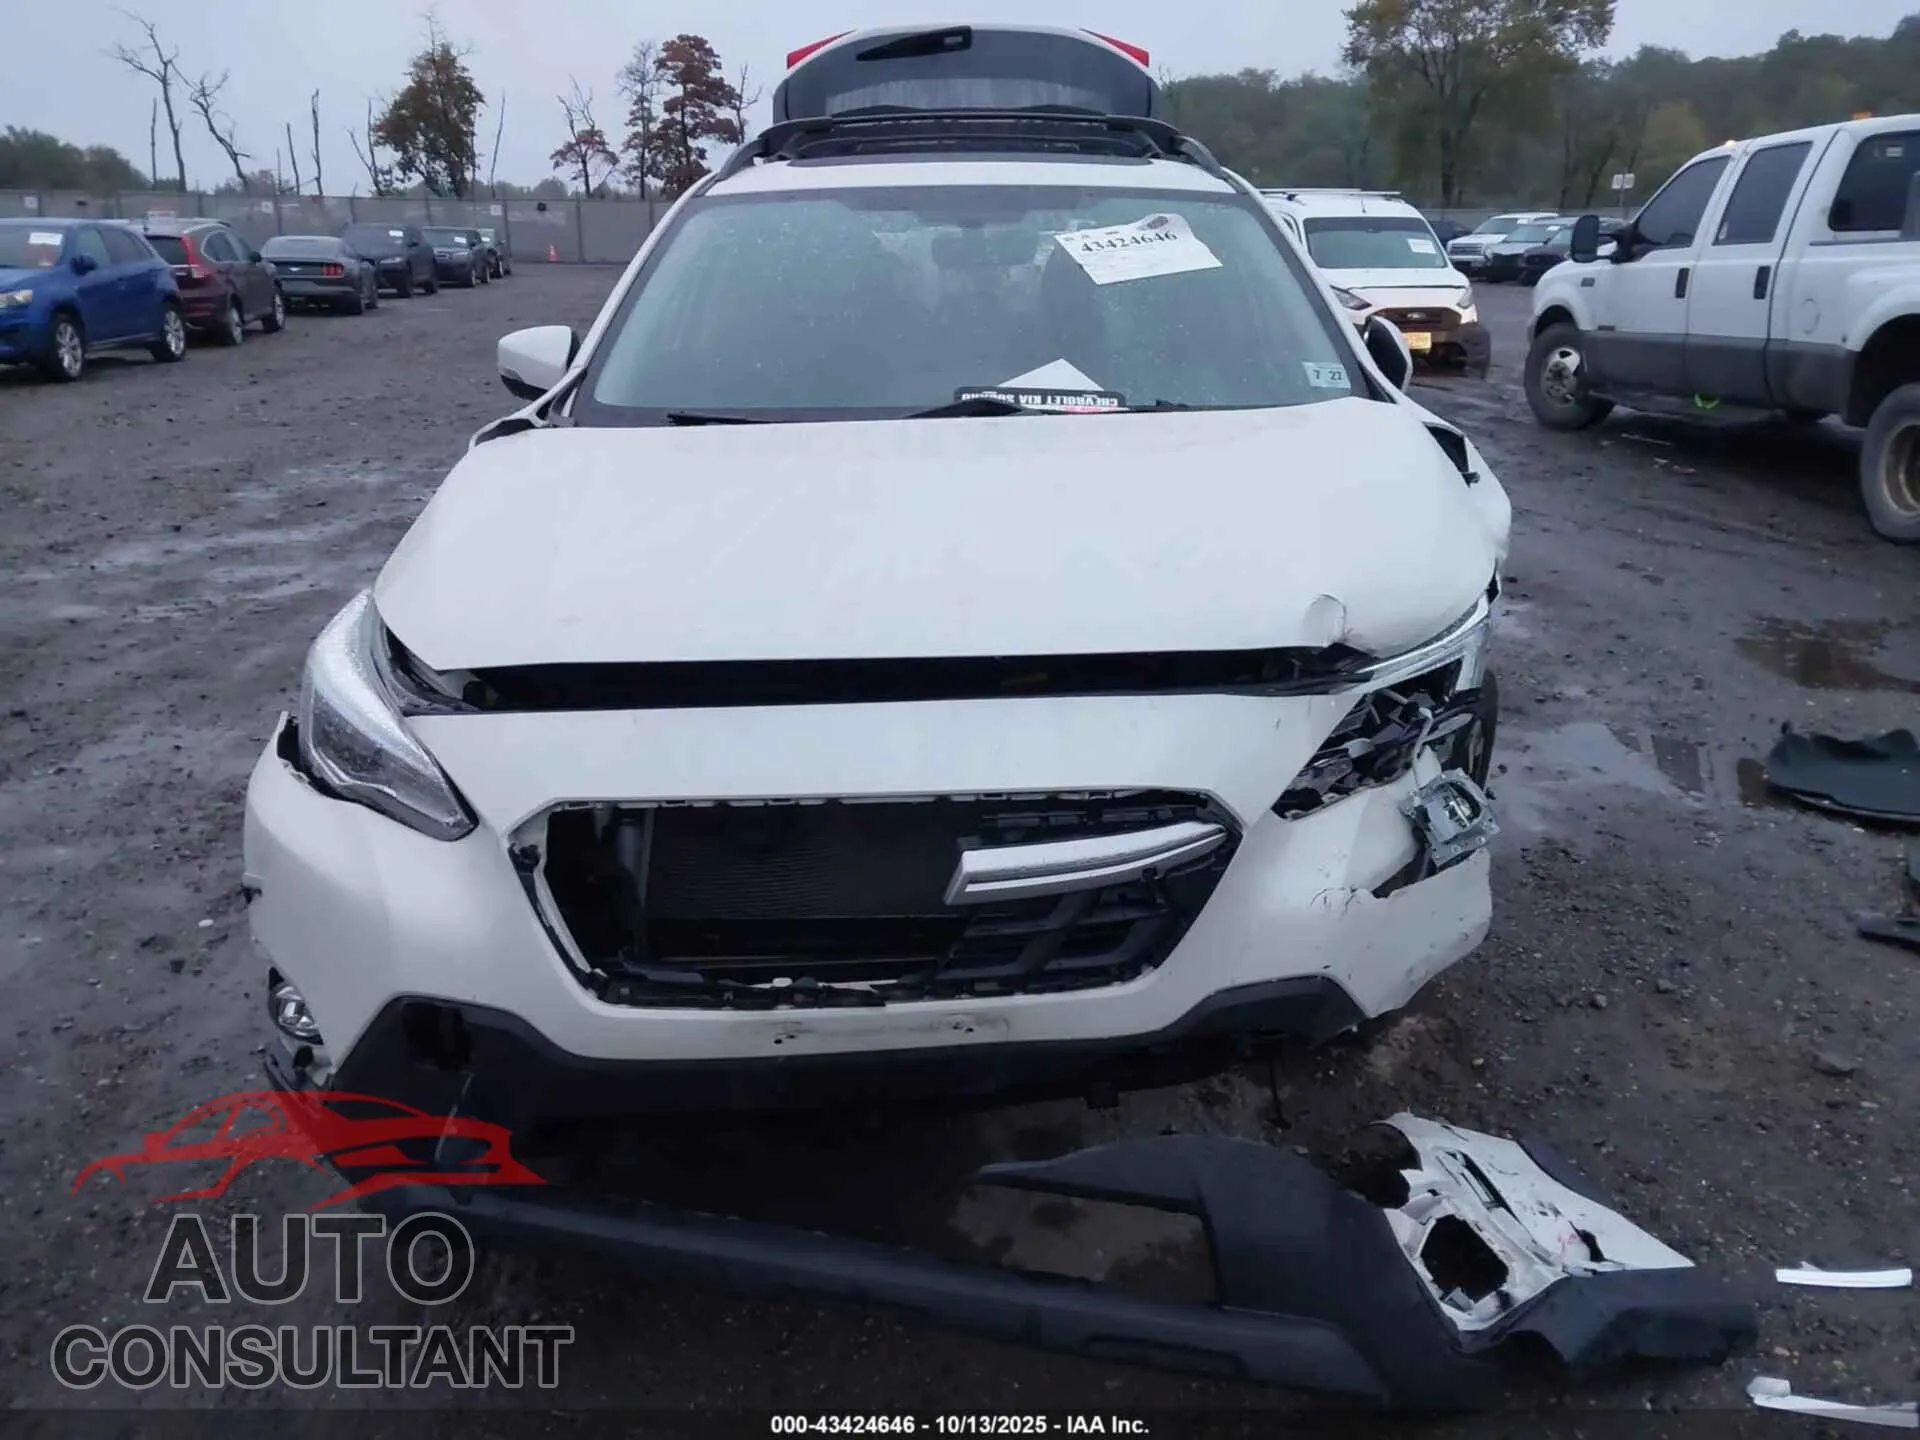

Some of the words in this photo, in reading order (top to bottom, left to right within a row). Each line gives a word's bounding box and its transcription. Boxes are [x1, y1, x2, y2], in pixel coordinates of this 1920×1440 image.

[1081, 231, 1178, 253] 43424646
[1019, 393, 1042, 406] KIA
[1046, 394, 1119, 407] CHEVROLET
